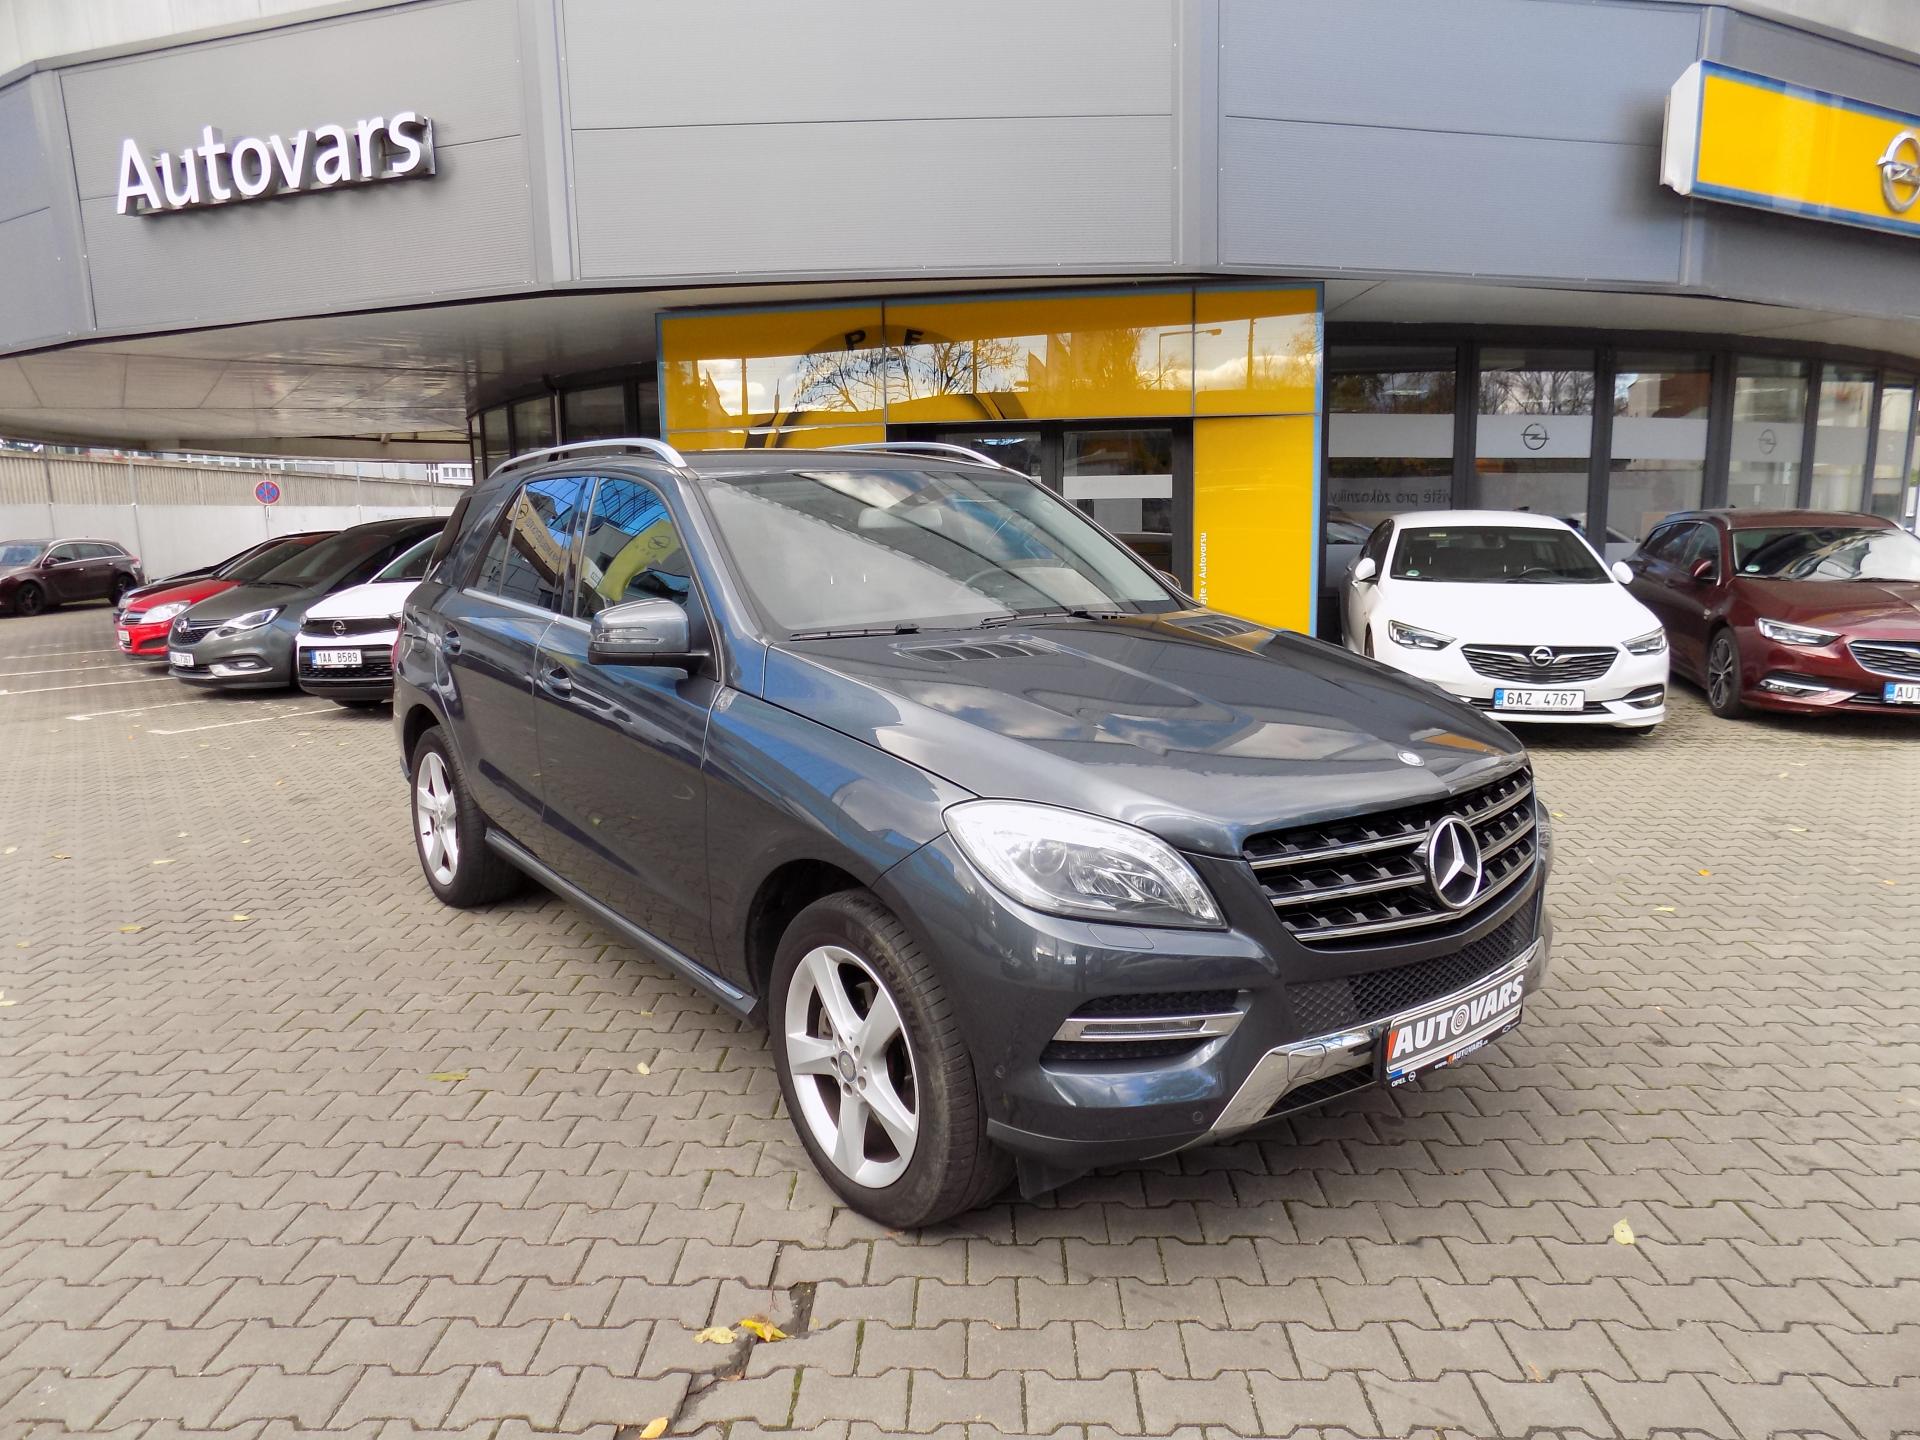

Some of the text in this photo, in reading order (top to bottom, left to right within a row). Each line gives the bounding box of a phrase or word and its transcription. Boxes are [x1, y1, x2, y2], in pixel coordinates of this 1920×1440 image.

[117, 111, 422, 214] Autovars
[1199, 532, 1207, 578] Autovarsu
[1507, 692, 1532, 705] 6AZ
[1544, 693, 1577, 706] 4767
[1391, 975, 1524, 1059] AUTOVARS
